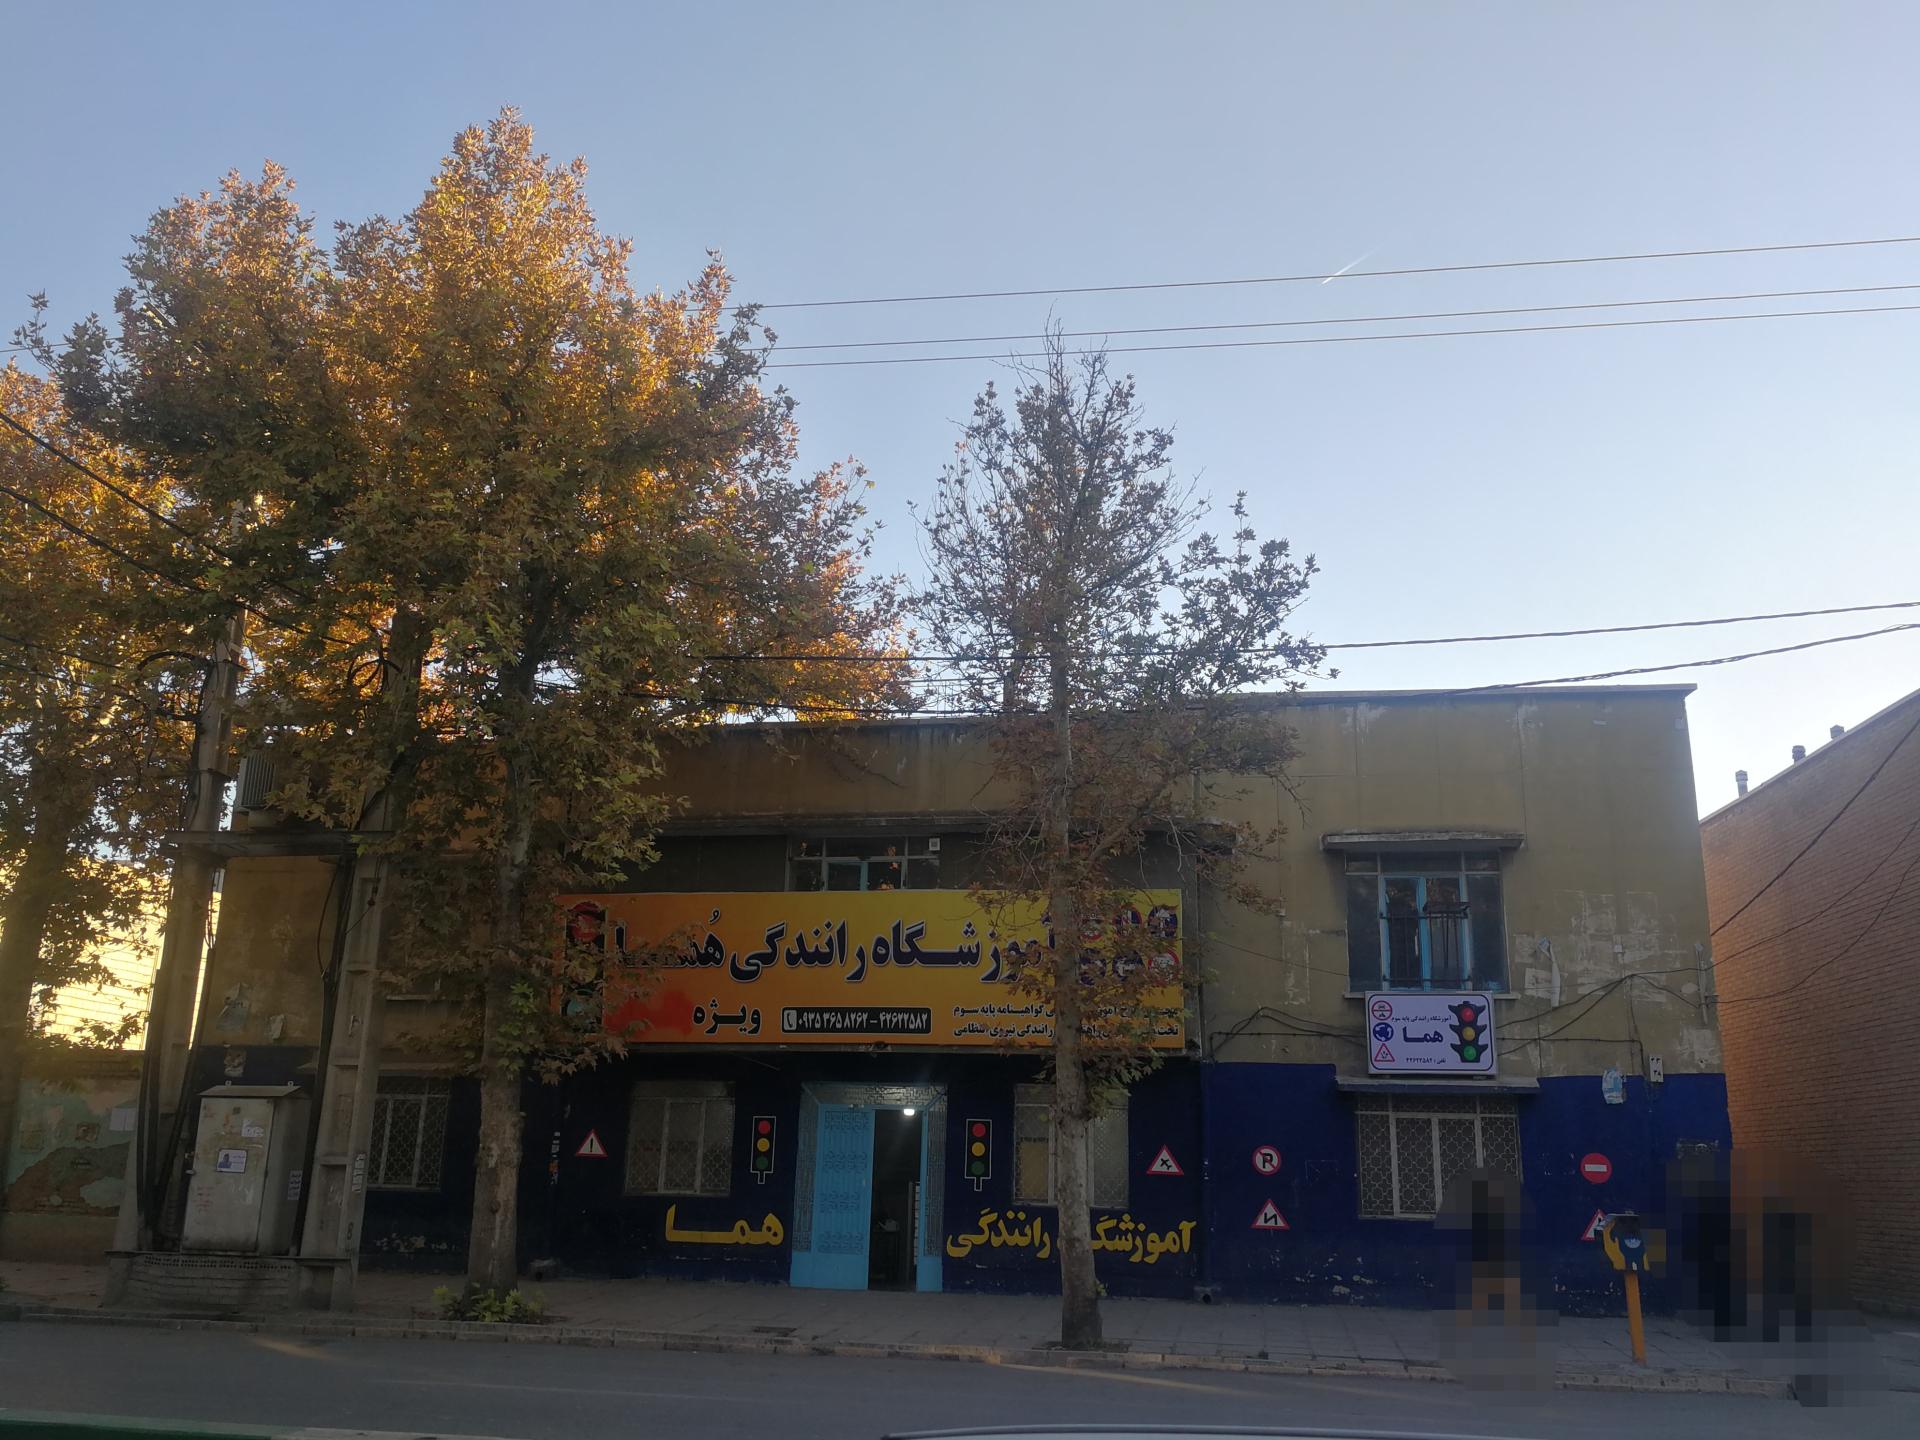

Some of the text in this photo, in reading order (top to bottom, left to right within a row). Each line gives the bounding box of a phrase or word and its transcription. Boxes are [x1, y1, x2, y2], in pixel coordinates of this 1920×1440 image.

[729, 919, 867, 983] رانندگی
[692, 997, 761, 1035] ویژه
[953, 1006, 979, 1017] سوم
[980, 1003, 995, 1017] پایه
[997, 1004, 1044, 1017] گواهینامه
[1017, 1023, 1053, 1038] رانندگی
[1402, 1026, 1444, 1043] هما
[664, 1203, 785, 1247] هما
[946, 1207, 1051, 1259] رانندگی
